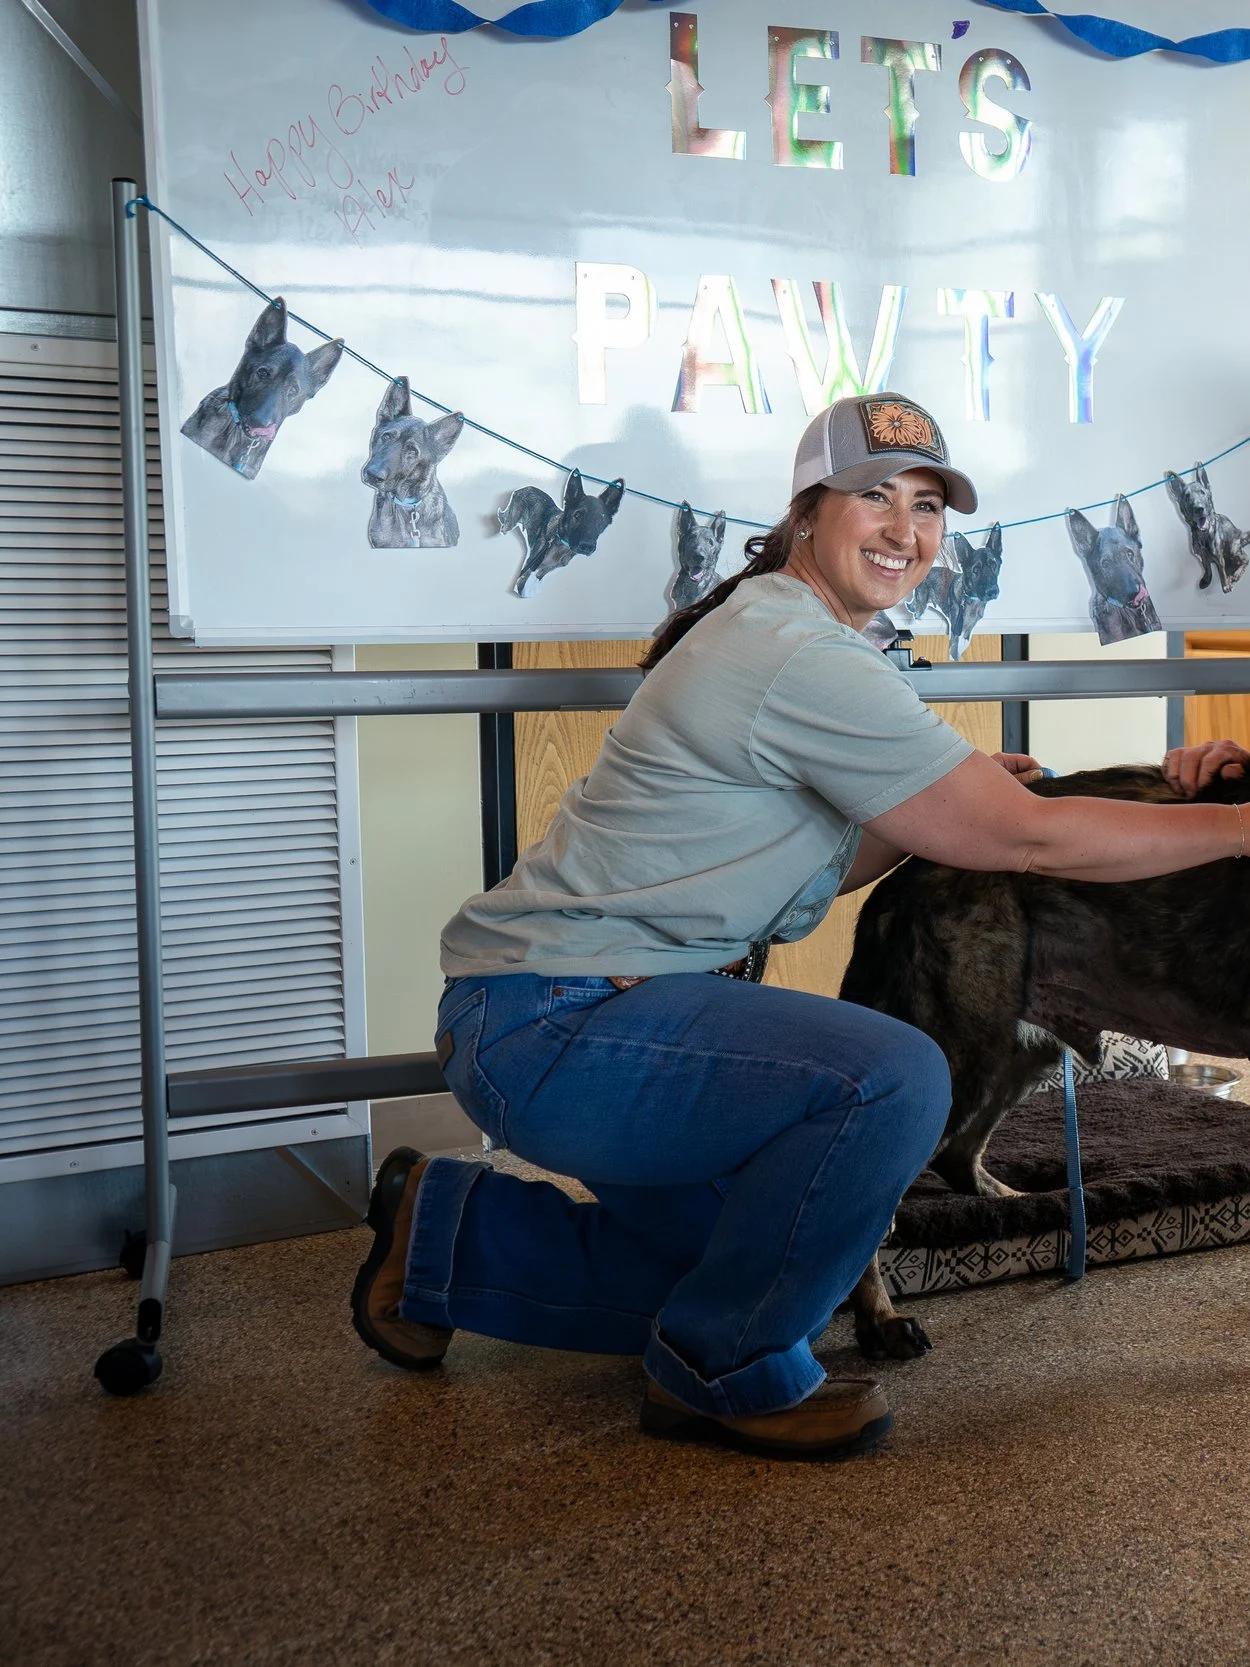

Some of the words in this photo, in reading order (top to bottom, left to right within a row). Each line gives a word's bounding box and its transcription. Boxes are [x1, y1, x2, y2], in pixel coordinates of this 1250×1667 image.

[224, 115, 353, 216] Happy
[328, 37, 470, 135] Birthday
[665, 11, 1032, 182] LET'S
[334, 167, 414, 249] Alex
[571, 261, 1126, 424] PAWTY
